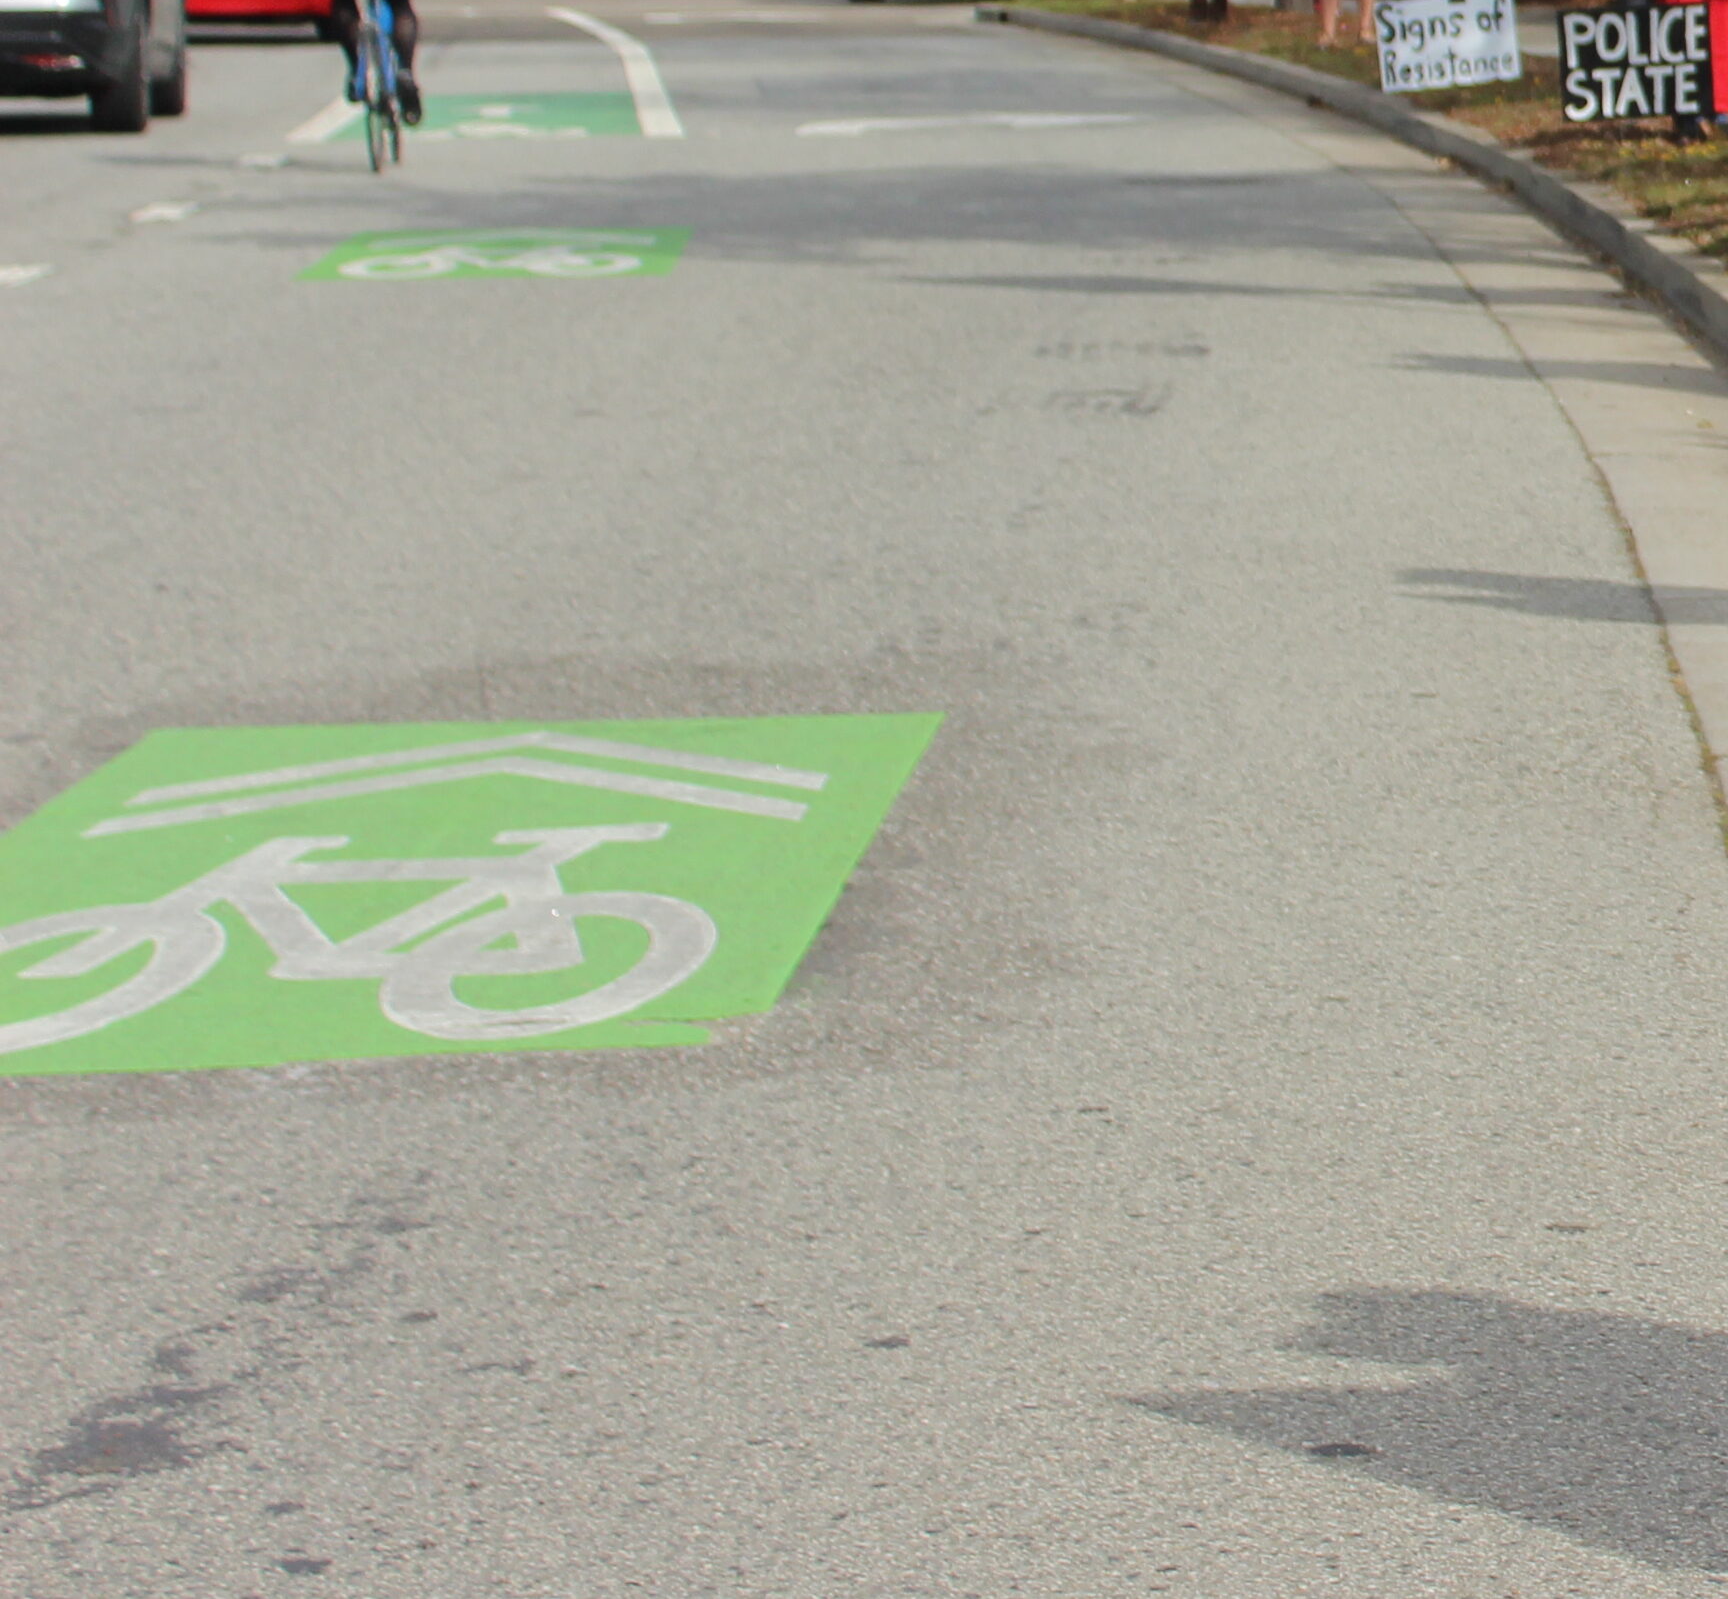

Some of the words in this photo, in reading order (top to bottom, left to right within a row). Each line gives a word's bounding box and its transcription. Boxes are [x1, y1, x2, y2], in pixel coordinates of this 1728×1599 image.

[1375, 2, 1466, 51] Signs
[1562, 4, 1709, 69] POLICE
[1384, 48, 1515, 88] Resistance
[1564, 62, 1700, 122] STATE
